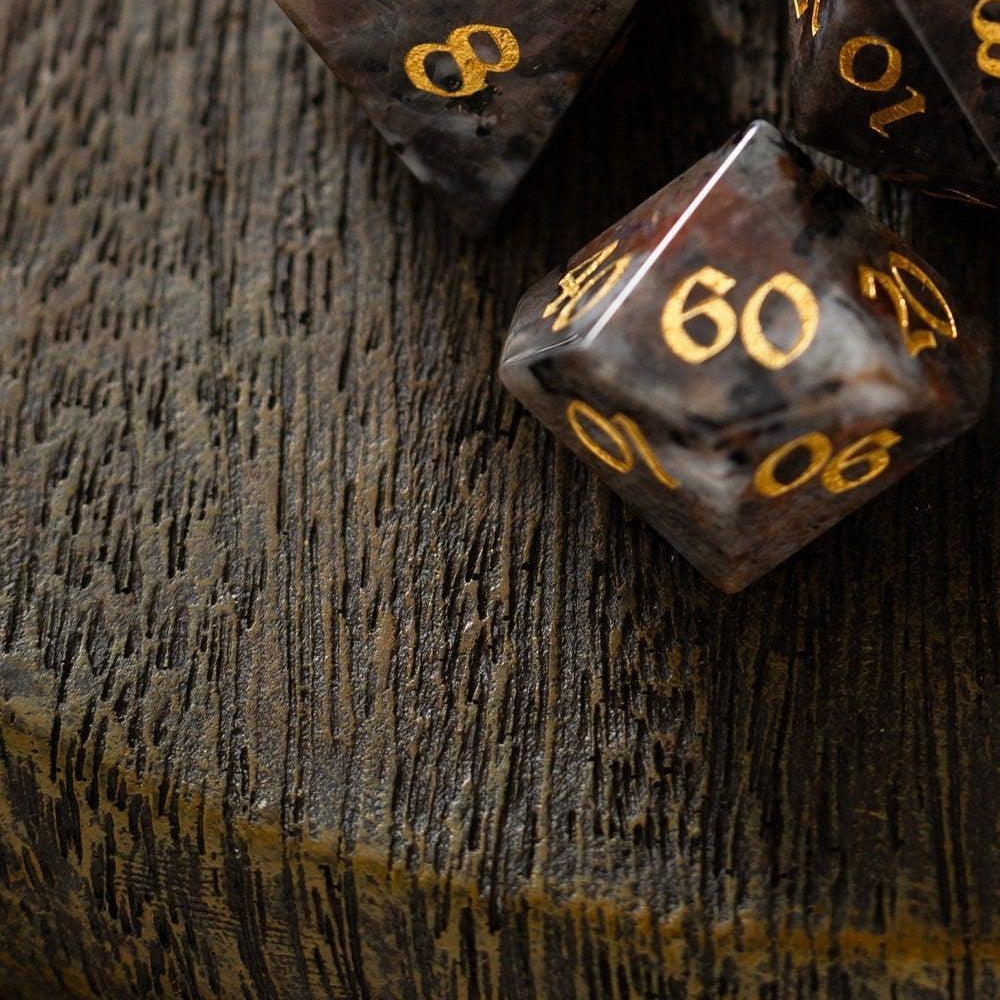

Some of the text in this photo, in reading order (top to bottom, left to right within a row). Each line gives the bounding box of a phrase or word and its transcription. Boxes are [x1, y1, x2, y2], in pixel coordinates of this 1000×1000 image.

[405, 23, 520, 98] 8
[839, 35, 926, 139] 10
[660, 265, 820, 371] 60
